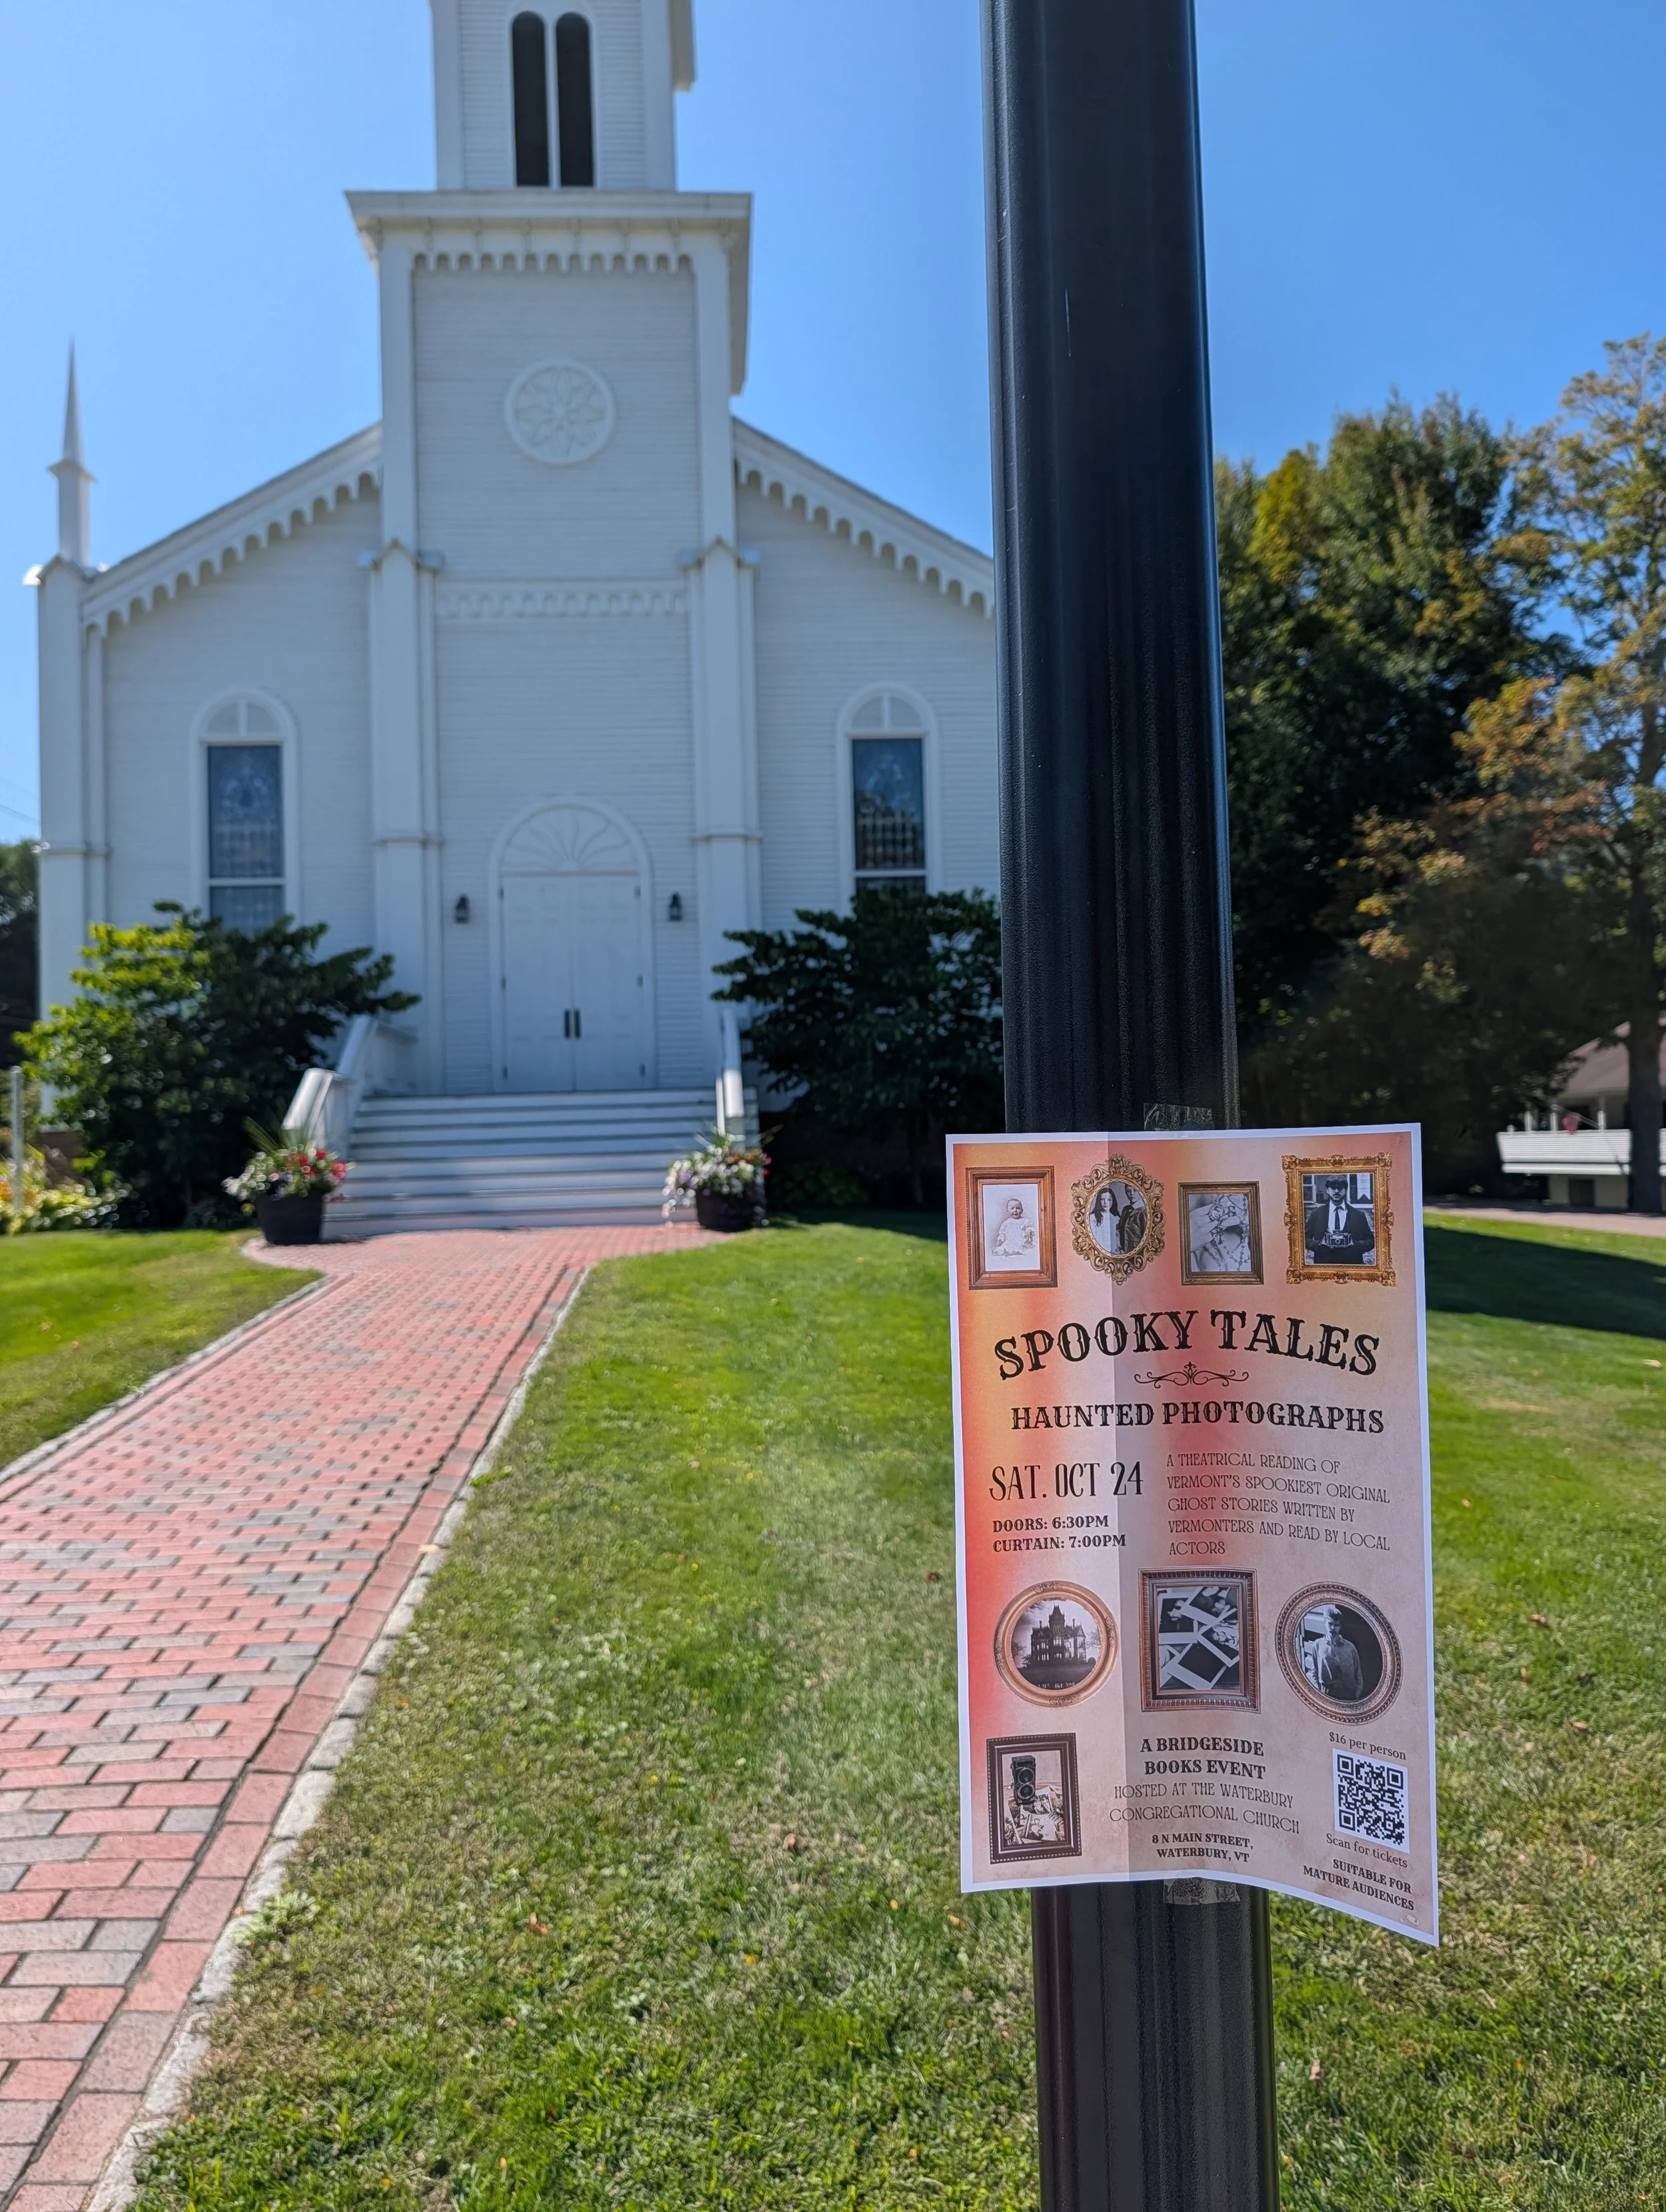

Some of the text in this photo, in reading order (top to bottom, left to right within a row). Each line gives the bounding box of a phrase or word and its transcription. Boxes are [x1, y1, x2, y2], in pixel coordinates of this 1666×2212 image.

[994, 1309, 1379, 1381] SPOOKY TALES
[1012, 1400, 1384, 1434] HAUNTED PHOTOGRAPHS
[1167, 1453, 1340, 1474] A THEATRICAL READING OF
[989, 1461, 1144, 1502] SAT. OCT 24
[1246, 1476, 1321, 1494] SPOOKIEST
[1326, 1483, 1391, 1503] ORIGINAL
[1168, 1496, 1355, 1522] GHOST STORIES WRITTEN BY
[992, 1516, 1109, 1533] DOORS: 6:30PM
[1168, 1520, 1391, 1551] VERMONTERS AND READ BY LOCAL
[992, 1534, 1127, 1553] CURTAIN: 7:00PM
[1169, 1542, 1226, 1556] ACTORS
[1140, 1737, 1264, 1756] A BRIDGESIDE
[1329, 1731, 1407, 1761] $16 per person
[1144, 1760, 1265, 1780] BOOKS EVENT
[1114, 1782, 1293, 1809] HOSTED AT THE WATERBURY
[1110, 1804, 1299, 1834] CONGREGATIONAL CHURCH
[1152, 1834, 1253, 1850] 8 N MAIN STREET,
[1157, 1848, 1250, 1862] WATERBURY, VT
[1325, 1832, 1407, 1868] Scan for tickets
[1303, 1866, 1415, 1911] MATURE AUDIENCES
[1333, 1860, 1412, 1894] SUITABLE FOR
